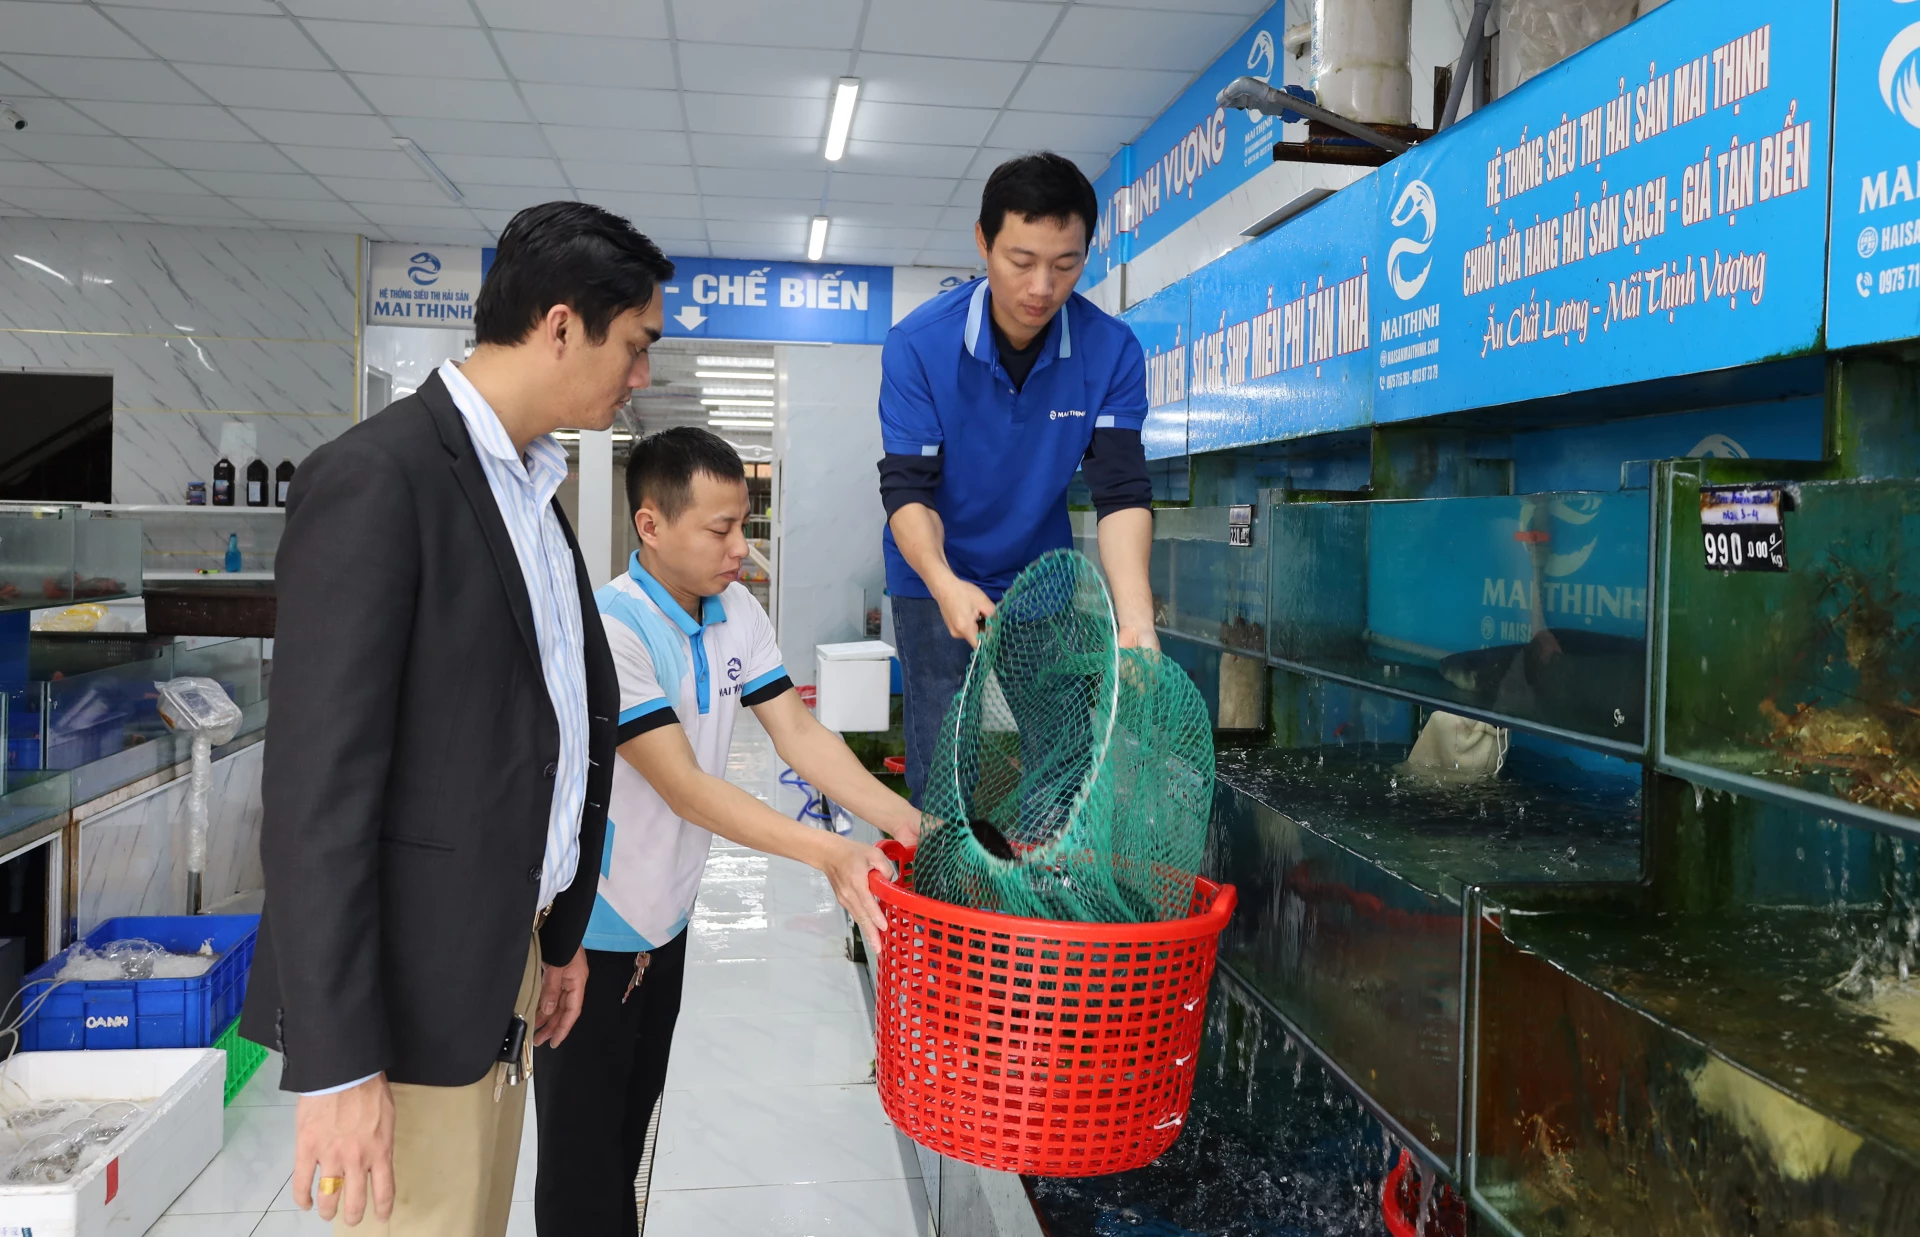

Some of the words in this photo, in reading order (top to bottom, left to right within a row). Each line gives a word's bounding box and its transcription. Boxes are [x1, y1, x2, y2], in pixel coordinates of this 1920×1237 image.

[1486, 146, 1502, 215] HỆ
[1504, 125, 1544, 200] THỐNG
[1546, 112, 1577, 182] SIÊU
[1580, 106, 1602, 173] THỊ
[1605, 76, 1632, 157] HẢI
[1634, 60, 1670, 144] SẢN
[1672, 53, 1708, 127] MAI
[1712, 23, 1770, 116] THỊNH
[1113, 160, 1160, 239] THỊNH
[1163, 106, 1226, 200] VƯỢNG
[1463, 225, 1495, 297] CHUỖI
[1498, 218, 1521, 286] CỬA
[1524, 213, 1559, 278] HÀNG
[1562, 191, 1586, 265] HẢI
[1588, 180, 1620, 257] SẢN
[1622, 175, 1666, 255] SẠCH
[1681, 145, 1711, 227] GIÁ
[1717, 135, 1755, 226] TẬN
[1759, 98, 1811, 202] BIỂN
[692, 267, 771, 306] CHẾ
[779, 270, 868, 311] BIẾN
[1480, 303, 1503, 359] Ăn
[1506, 288, 1540, 348] Chất
[1542, 298, 1589, 347] Lượng
[1603, 270, 1642, 333] Mãi
[1644, 254, 1697, 324] Thịnh
[1700, 248, 1767, 310] Vượng
[1878, 266, 1905, 295] 0975
[374, 301, 411, 317] MAI
[415, 303, 473, 321] THỊNH
[1226, 320, 1249, 387] SHIP
[1252, 285, 1282, 380] MIỄN
[1283, 281, 1306, 371] PHÍ
[1308, 274, 1335, 379] TẬN
[1337, 255, 1369, 356] NHÀ
[1380, 315, 1402, 342] MAI
[1403, 303, 1440, 338] THỊNH
[1704, 532, 1742, 565] 990
[1482, 577, 1535, 610] MAI
[1544, 582, 1648, 625] THỊNH
